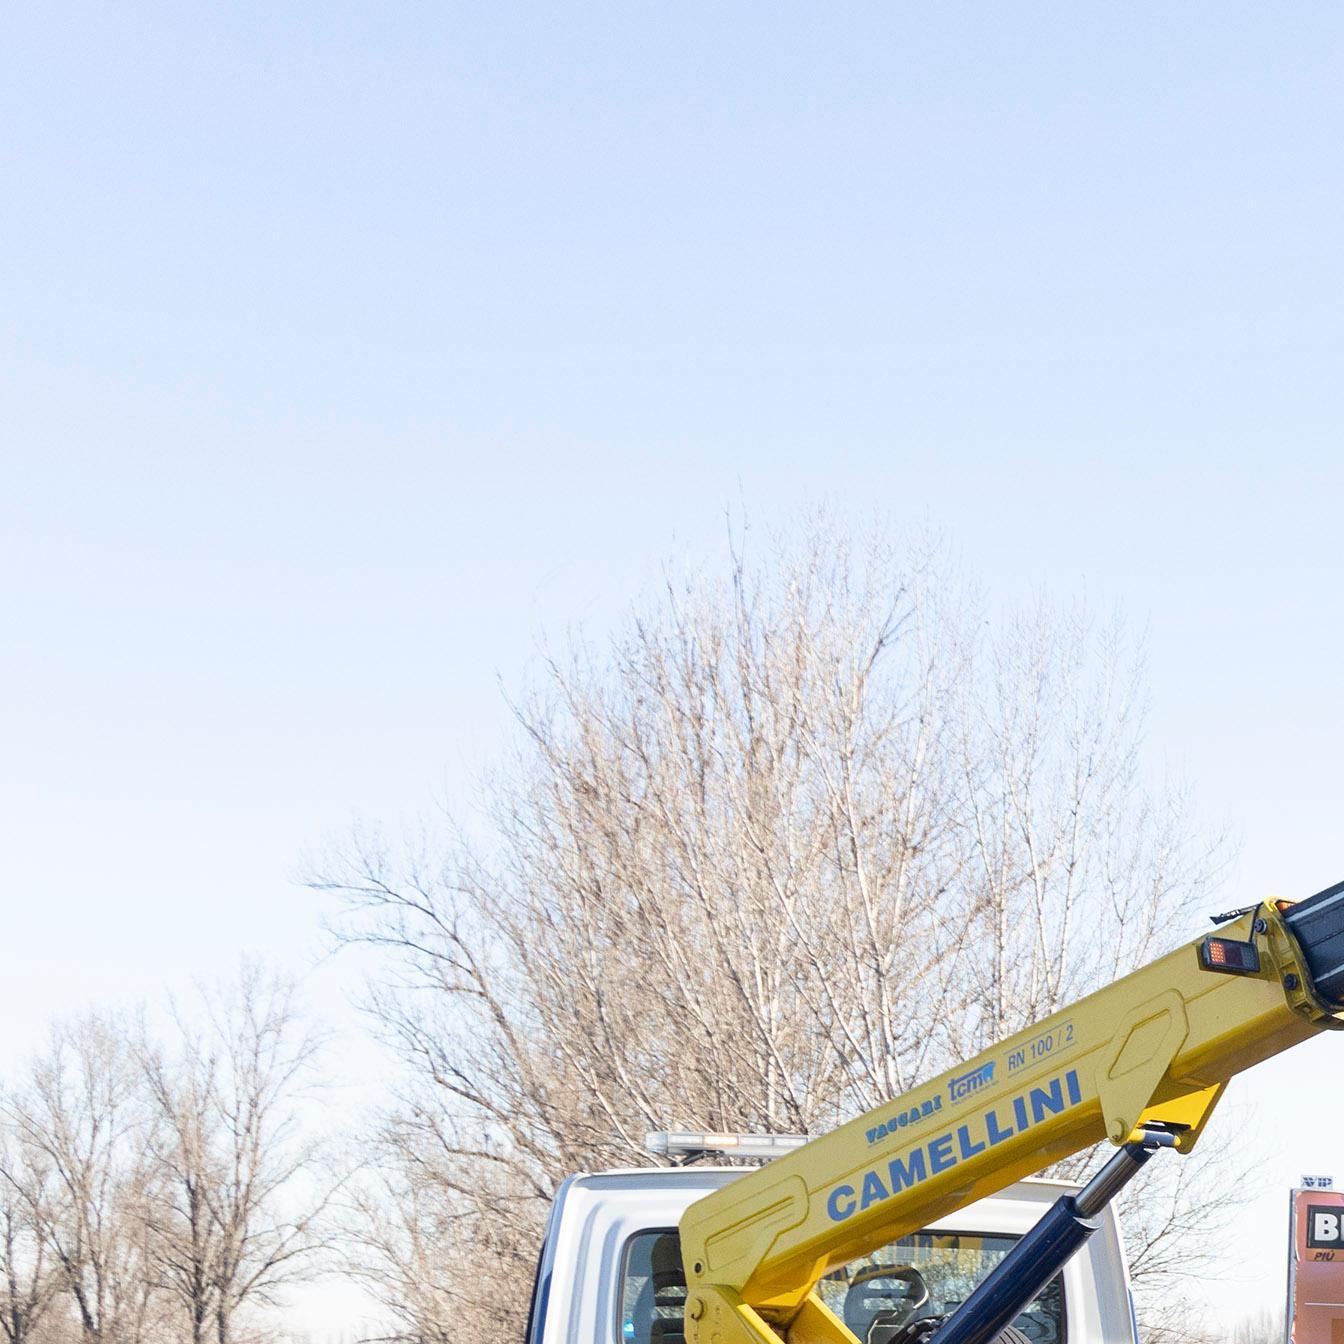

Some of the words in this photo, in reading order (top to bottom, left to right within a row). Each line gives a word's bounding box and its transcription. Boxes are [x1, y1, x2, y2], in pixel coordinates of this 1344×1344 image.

[1008, 1048, 1025, 1072] RN
[1031, 1035, 1053, 1059] 100
[1066, 1024, 1074, 1041] 2
[827, 1069, 1082, 1222] CAMELLINI
